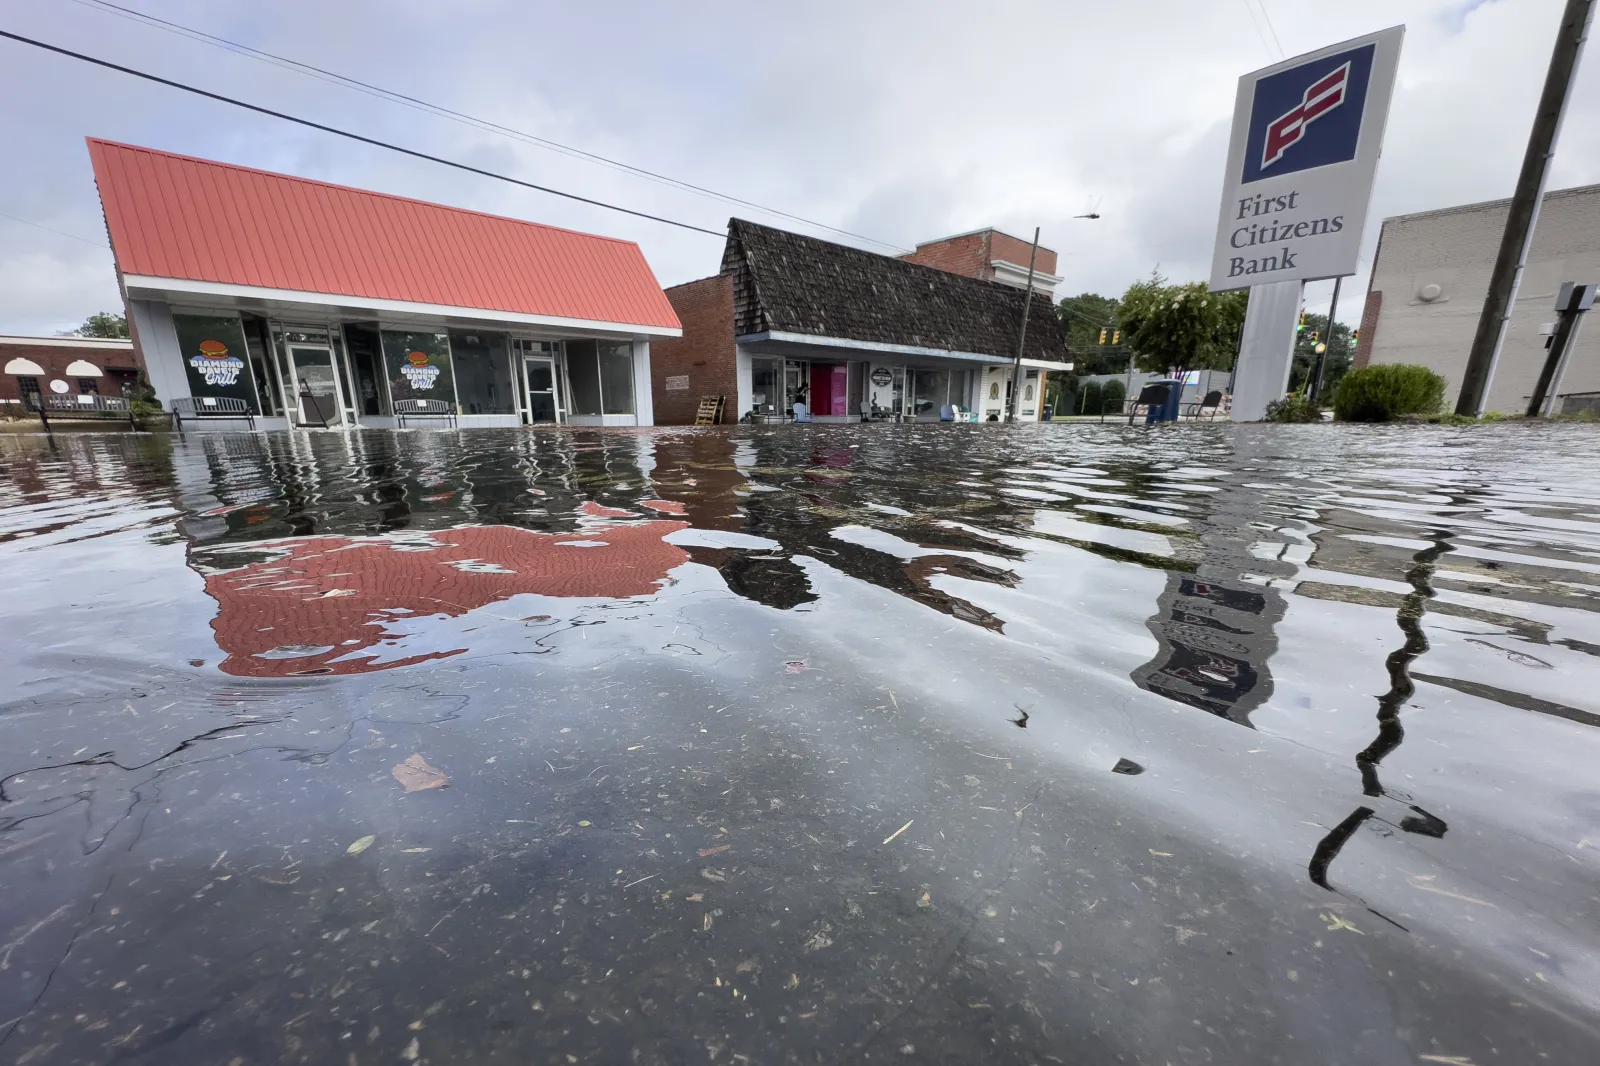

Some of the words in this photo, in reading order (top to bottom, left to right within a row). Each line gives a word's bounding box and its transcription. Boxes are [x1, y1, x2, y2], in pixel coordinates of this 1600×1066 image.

[1236, 190, 1300, 221] First
[1230, 216, 1344, 249] Citizens
[1227, 247, 1298, 278] Bank
[189, 359, 244, 369] DIAMOND
[400, 367, 440, 375] DIAMOND
[204, 372, 238, 385] Grill
[411, 378, 435, 389] Grill
